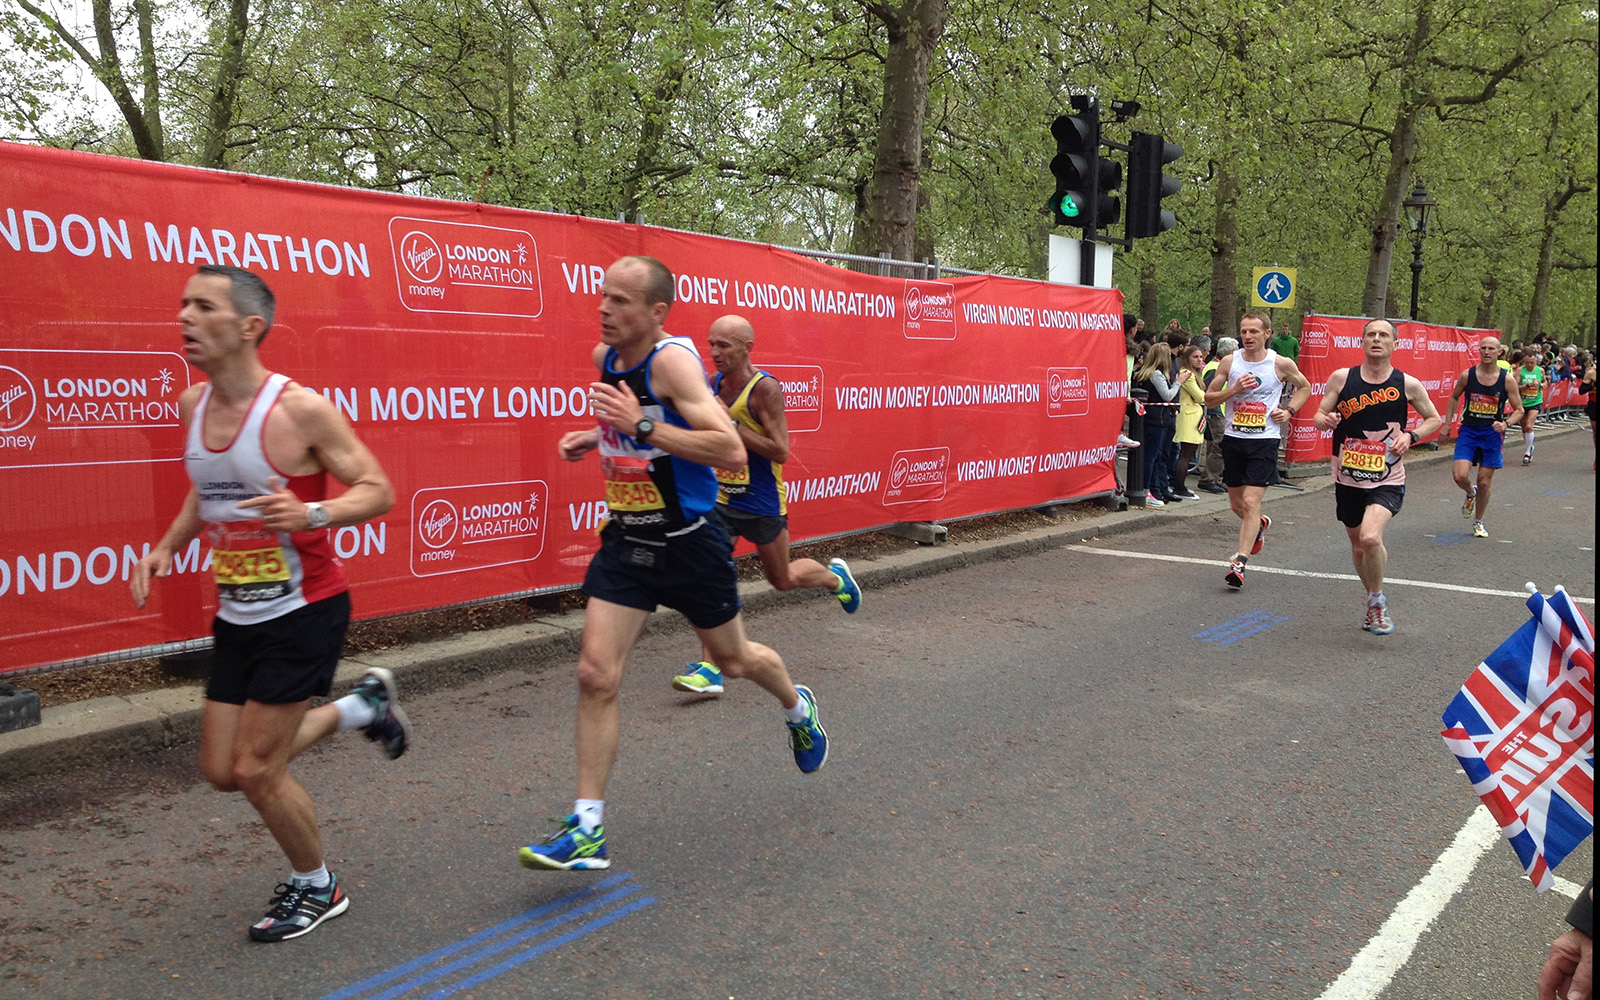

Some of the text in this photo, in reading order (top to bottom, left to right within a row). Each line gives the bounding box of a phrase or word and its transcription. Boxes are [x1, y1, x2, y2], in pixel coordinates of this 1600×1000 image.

[145, 220, 371, 278] MARATHON
[407, 239, 436, 274] Virgin
[445, 243, 511, 264] LONDON
[448, 263, 533, 285] MARATHON
[409, 285, 445, 300] money
[735, 280, 806, 312] LONDON
[810, 288, 896, 319] MARATHON
[921, 295, 947, 306] LONDON
[922, 307, 953, 318] MARATHON
[962, 302, 997, 324] VIRGIN
[998, 305, 1035, 327] MONEY
[1037, 308, 1079, 329] LONDON
[43, 378, 147, 398] LONDON
[1062, 379, 1082, 388] LONDON
[1094, 381, 1120, 399] VIRGIN
[370, 386, 484, 421] MONEY
[835, 383, 1040, 410] VIRGIN MONEY LONDON MARATHON
[1337, 386, 1400, 420] BEANO
[46, 401, 180, 422] MARATHON
[1233, 412, 1265, 425] 30705
[909, 460, 938, 473] LONDON
[957, 458, 996, 482] VIRGIN
[997, 455, 1037, 477] MONEY
[1038, 450, 1077, 472] LONDON
[1344, 451, 1384, 469] 29810
[802, 471, 882, 501] MARATHON
[907, 471, 944, 484] MARATHON
[462, 501, 522, 521] LONDON
[424, 508, 453, 540] Virgin
[462, 516, 539, 539] MARATHON
[421, 549, 455, 562] money
